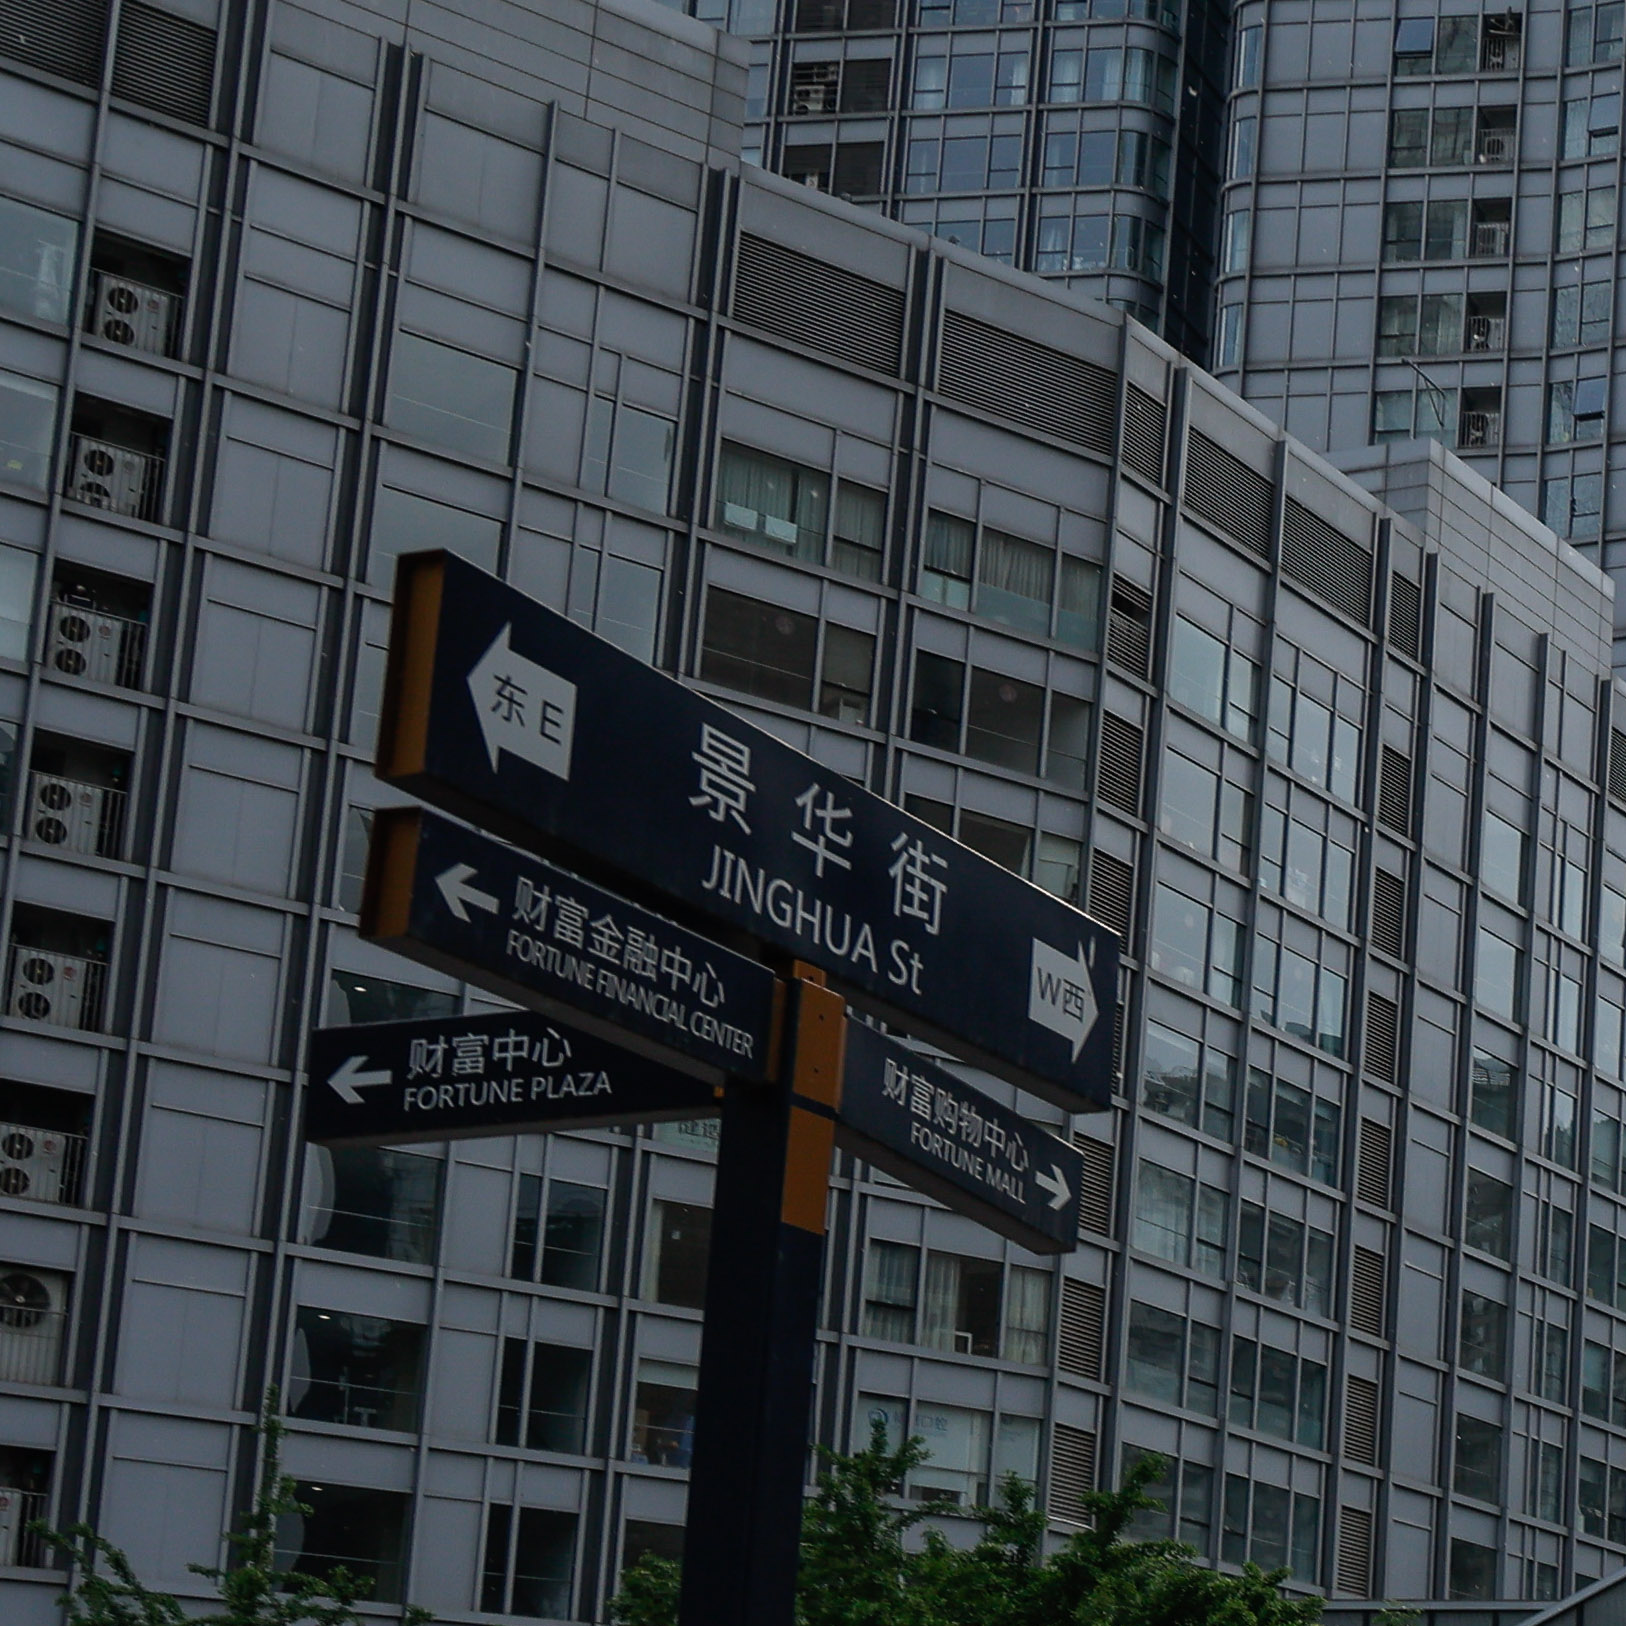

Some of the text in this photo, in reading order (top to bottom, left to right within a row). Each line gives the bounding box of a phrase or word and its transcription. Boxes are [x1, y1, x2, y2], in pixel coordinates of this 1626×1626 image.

[491, 673, 564, 747] 东 E
[688, 721, 951, 937] 景华街
[510, 874, 726, 1010] 财富金融中心
[702, 843, 926, 996] JINGHUA St
[506, 929, 754, 1060] FORTUNE FINANCIAL CENTER
[1036, 965, 1086, 1024] W 西
[403, 1070, 613, 1112] FORTUNE PLAZA
[406, 1026, 572, 1080] 财富中心
[882, 1056, 1030, 1173] 财富购物中心
[910, 1121, 1027, 1205] FORTUNE MALL
